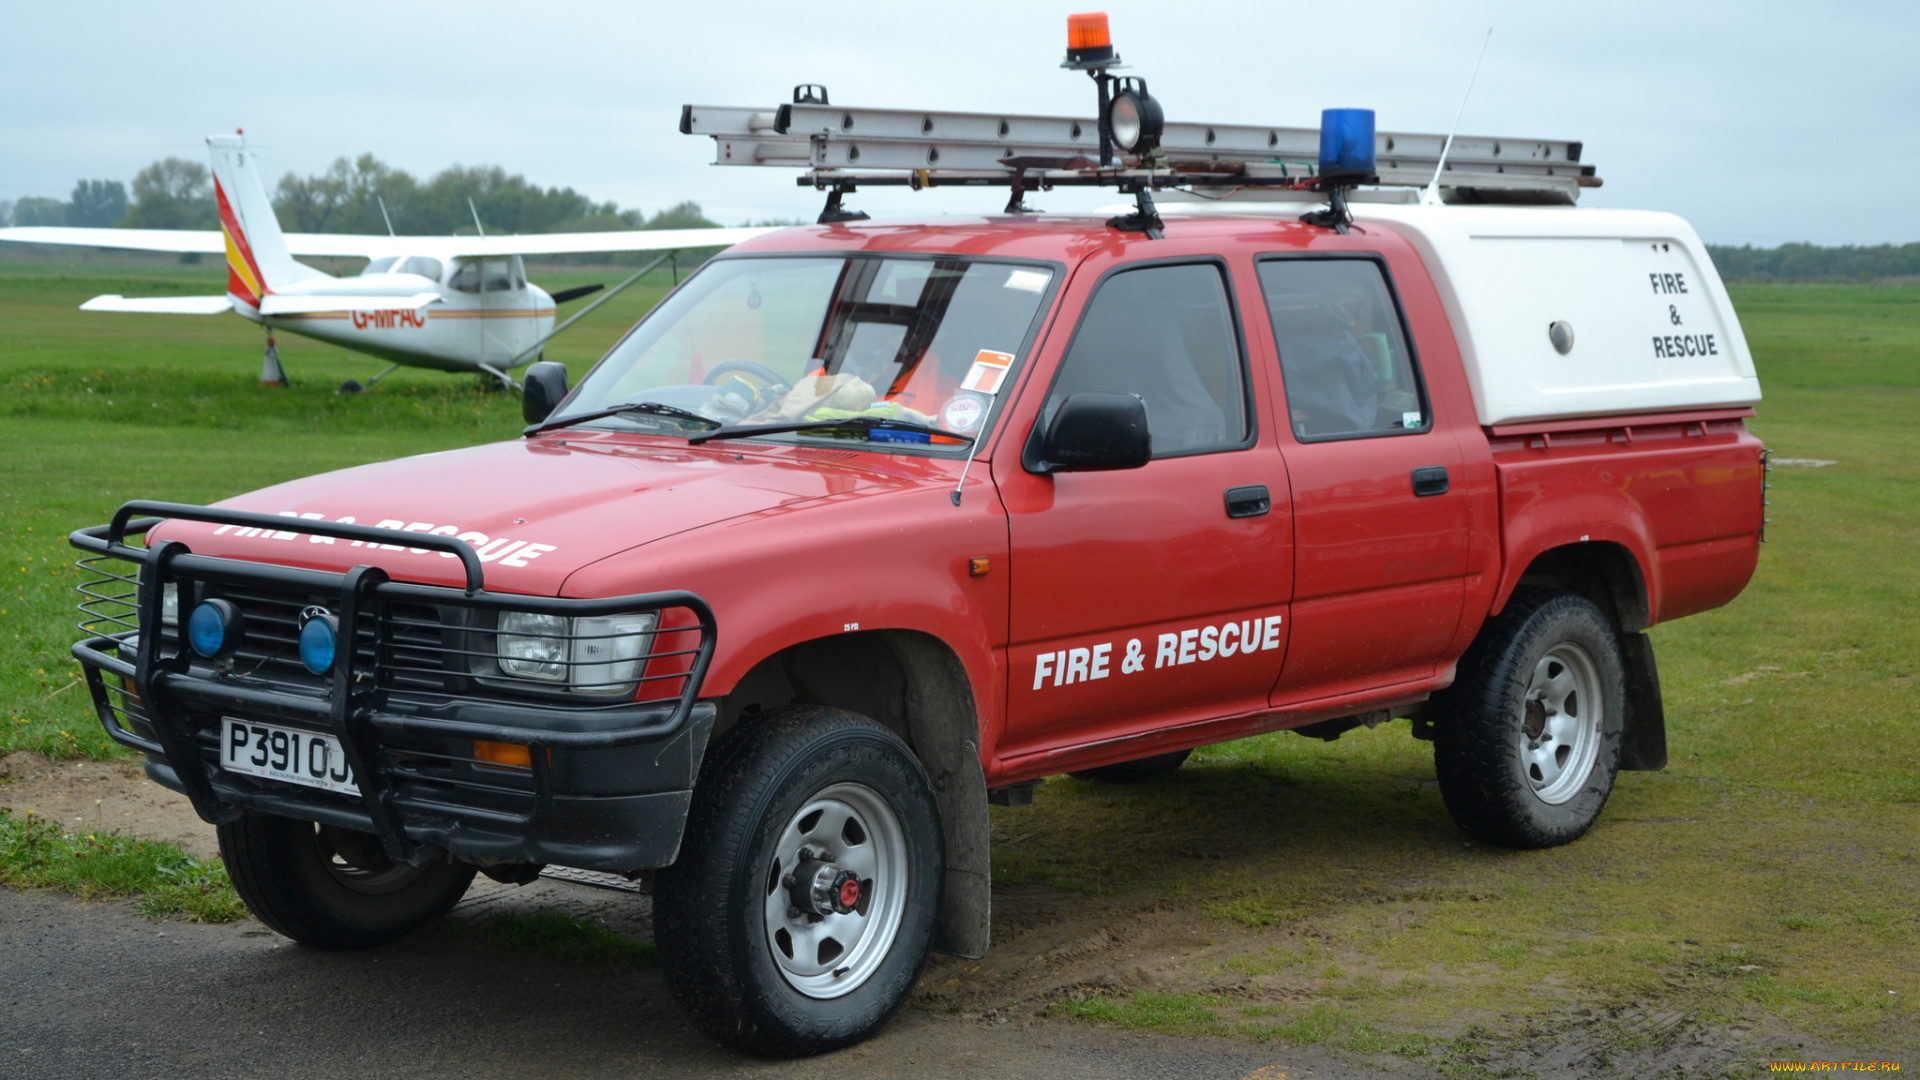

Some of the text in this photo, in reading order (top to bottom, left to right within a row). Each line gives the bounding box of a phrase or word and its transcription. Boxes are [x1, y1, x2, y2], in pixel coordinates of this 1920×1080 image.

[1649, 273, 1688, 294] FIRE
[1669, 304, 1683, 326] &
[1652, 334, 1718, 359] RESCUE
[1032, 615, 1282, 691] FIRE & RESCUE
[230, 722, 357, 786] P391 OJ
